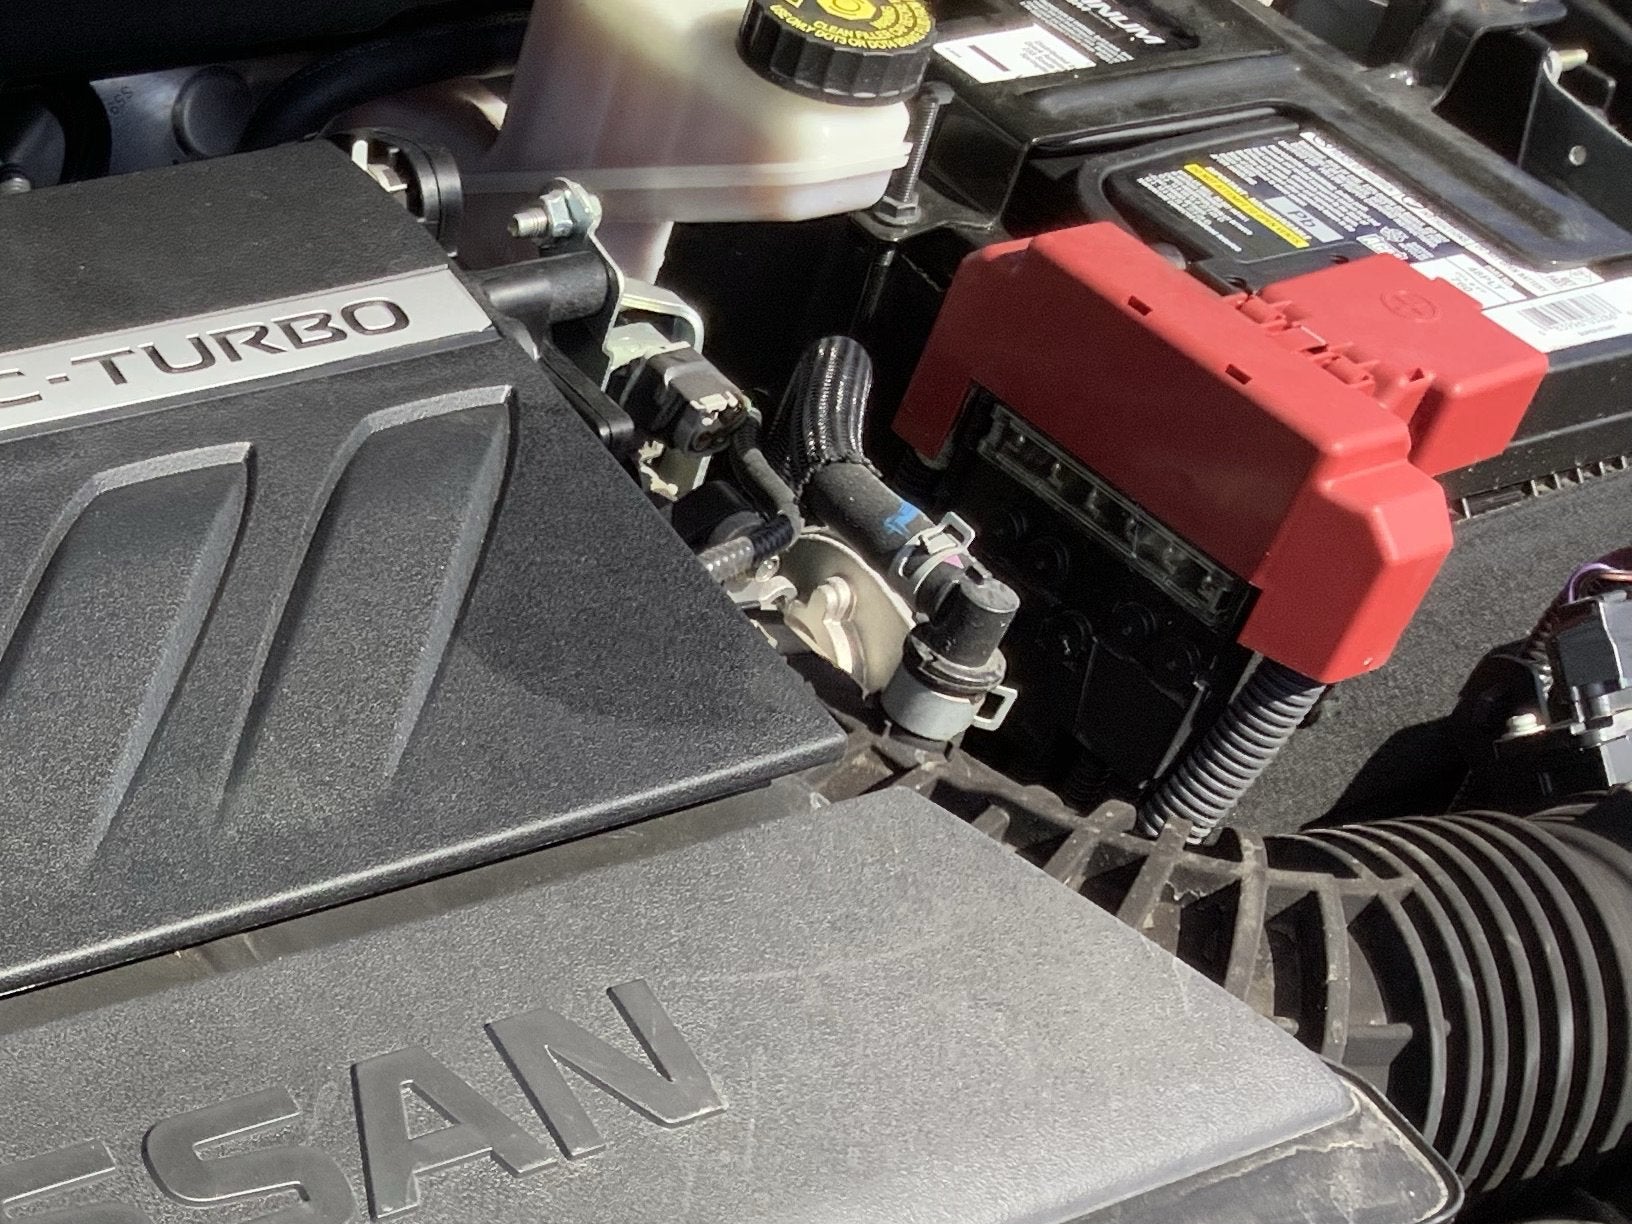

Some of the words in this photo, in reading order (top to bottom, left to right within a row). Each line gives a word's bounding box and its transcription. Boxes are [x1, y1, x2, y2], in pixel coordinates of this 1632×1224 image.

[786, 16, 815, 33] ONLY
[848, 36, 867, 48] OR
[814, 20, 854, 38] CLEAN
[856, 30, 894, 40] FILLER
[1288, 210, 1315, 228] Pb
